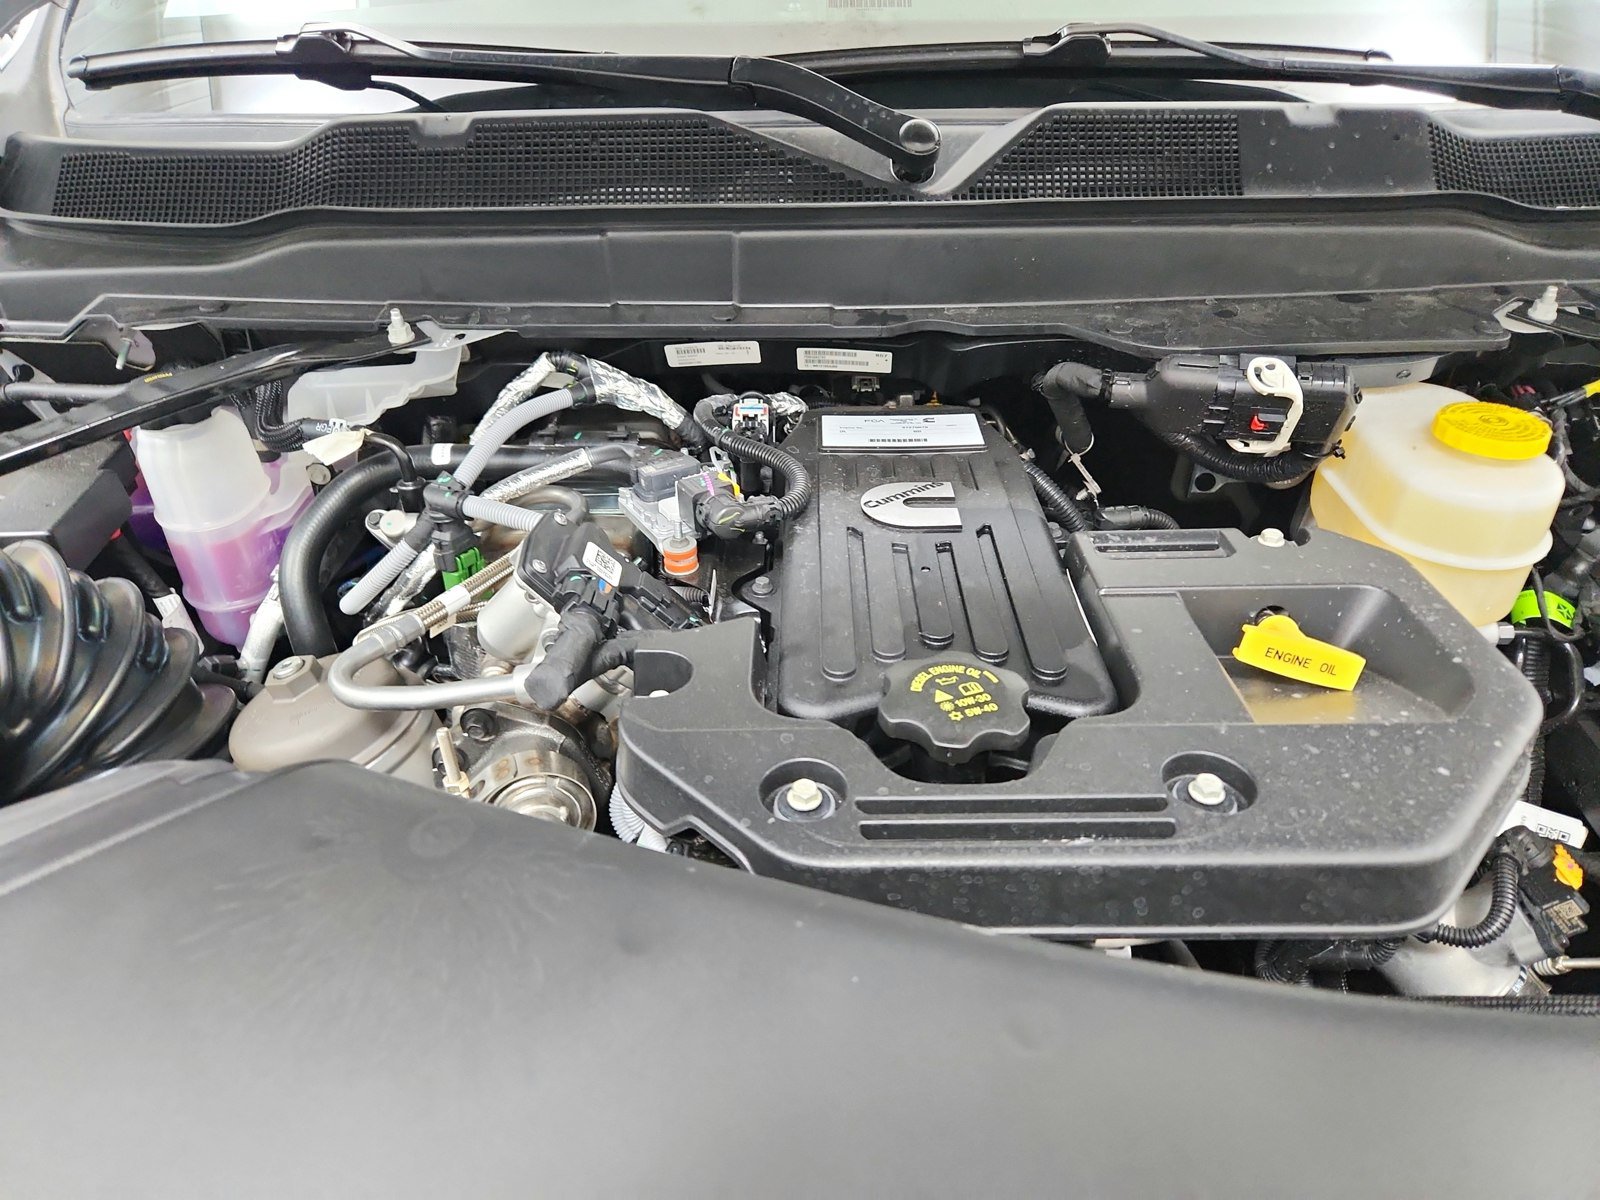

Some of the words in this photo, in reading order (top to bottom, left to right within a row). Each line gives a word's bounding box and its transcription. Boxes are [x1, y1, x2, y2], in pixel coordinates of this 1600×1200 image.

[863, 482, 945, 508] Cummins
[1265, 647, 1312, 669] ENGINE
[1319, 662, 1337, 676] OIL
[928, 664, 966, 676] ENGINE
[965, 667, 982, 679] OIL
[954, 693, 992, 707] 10W-30
[964, 702, 999, 717] 5W-40
